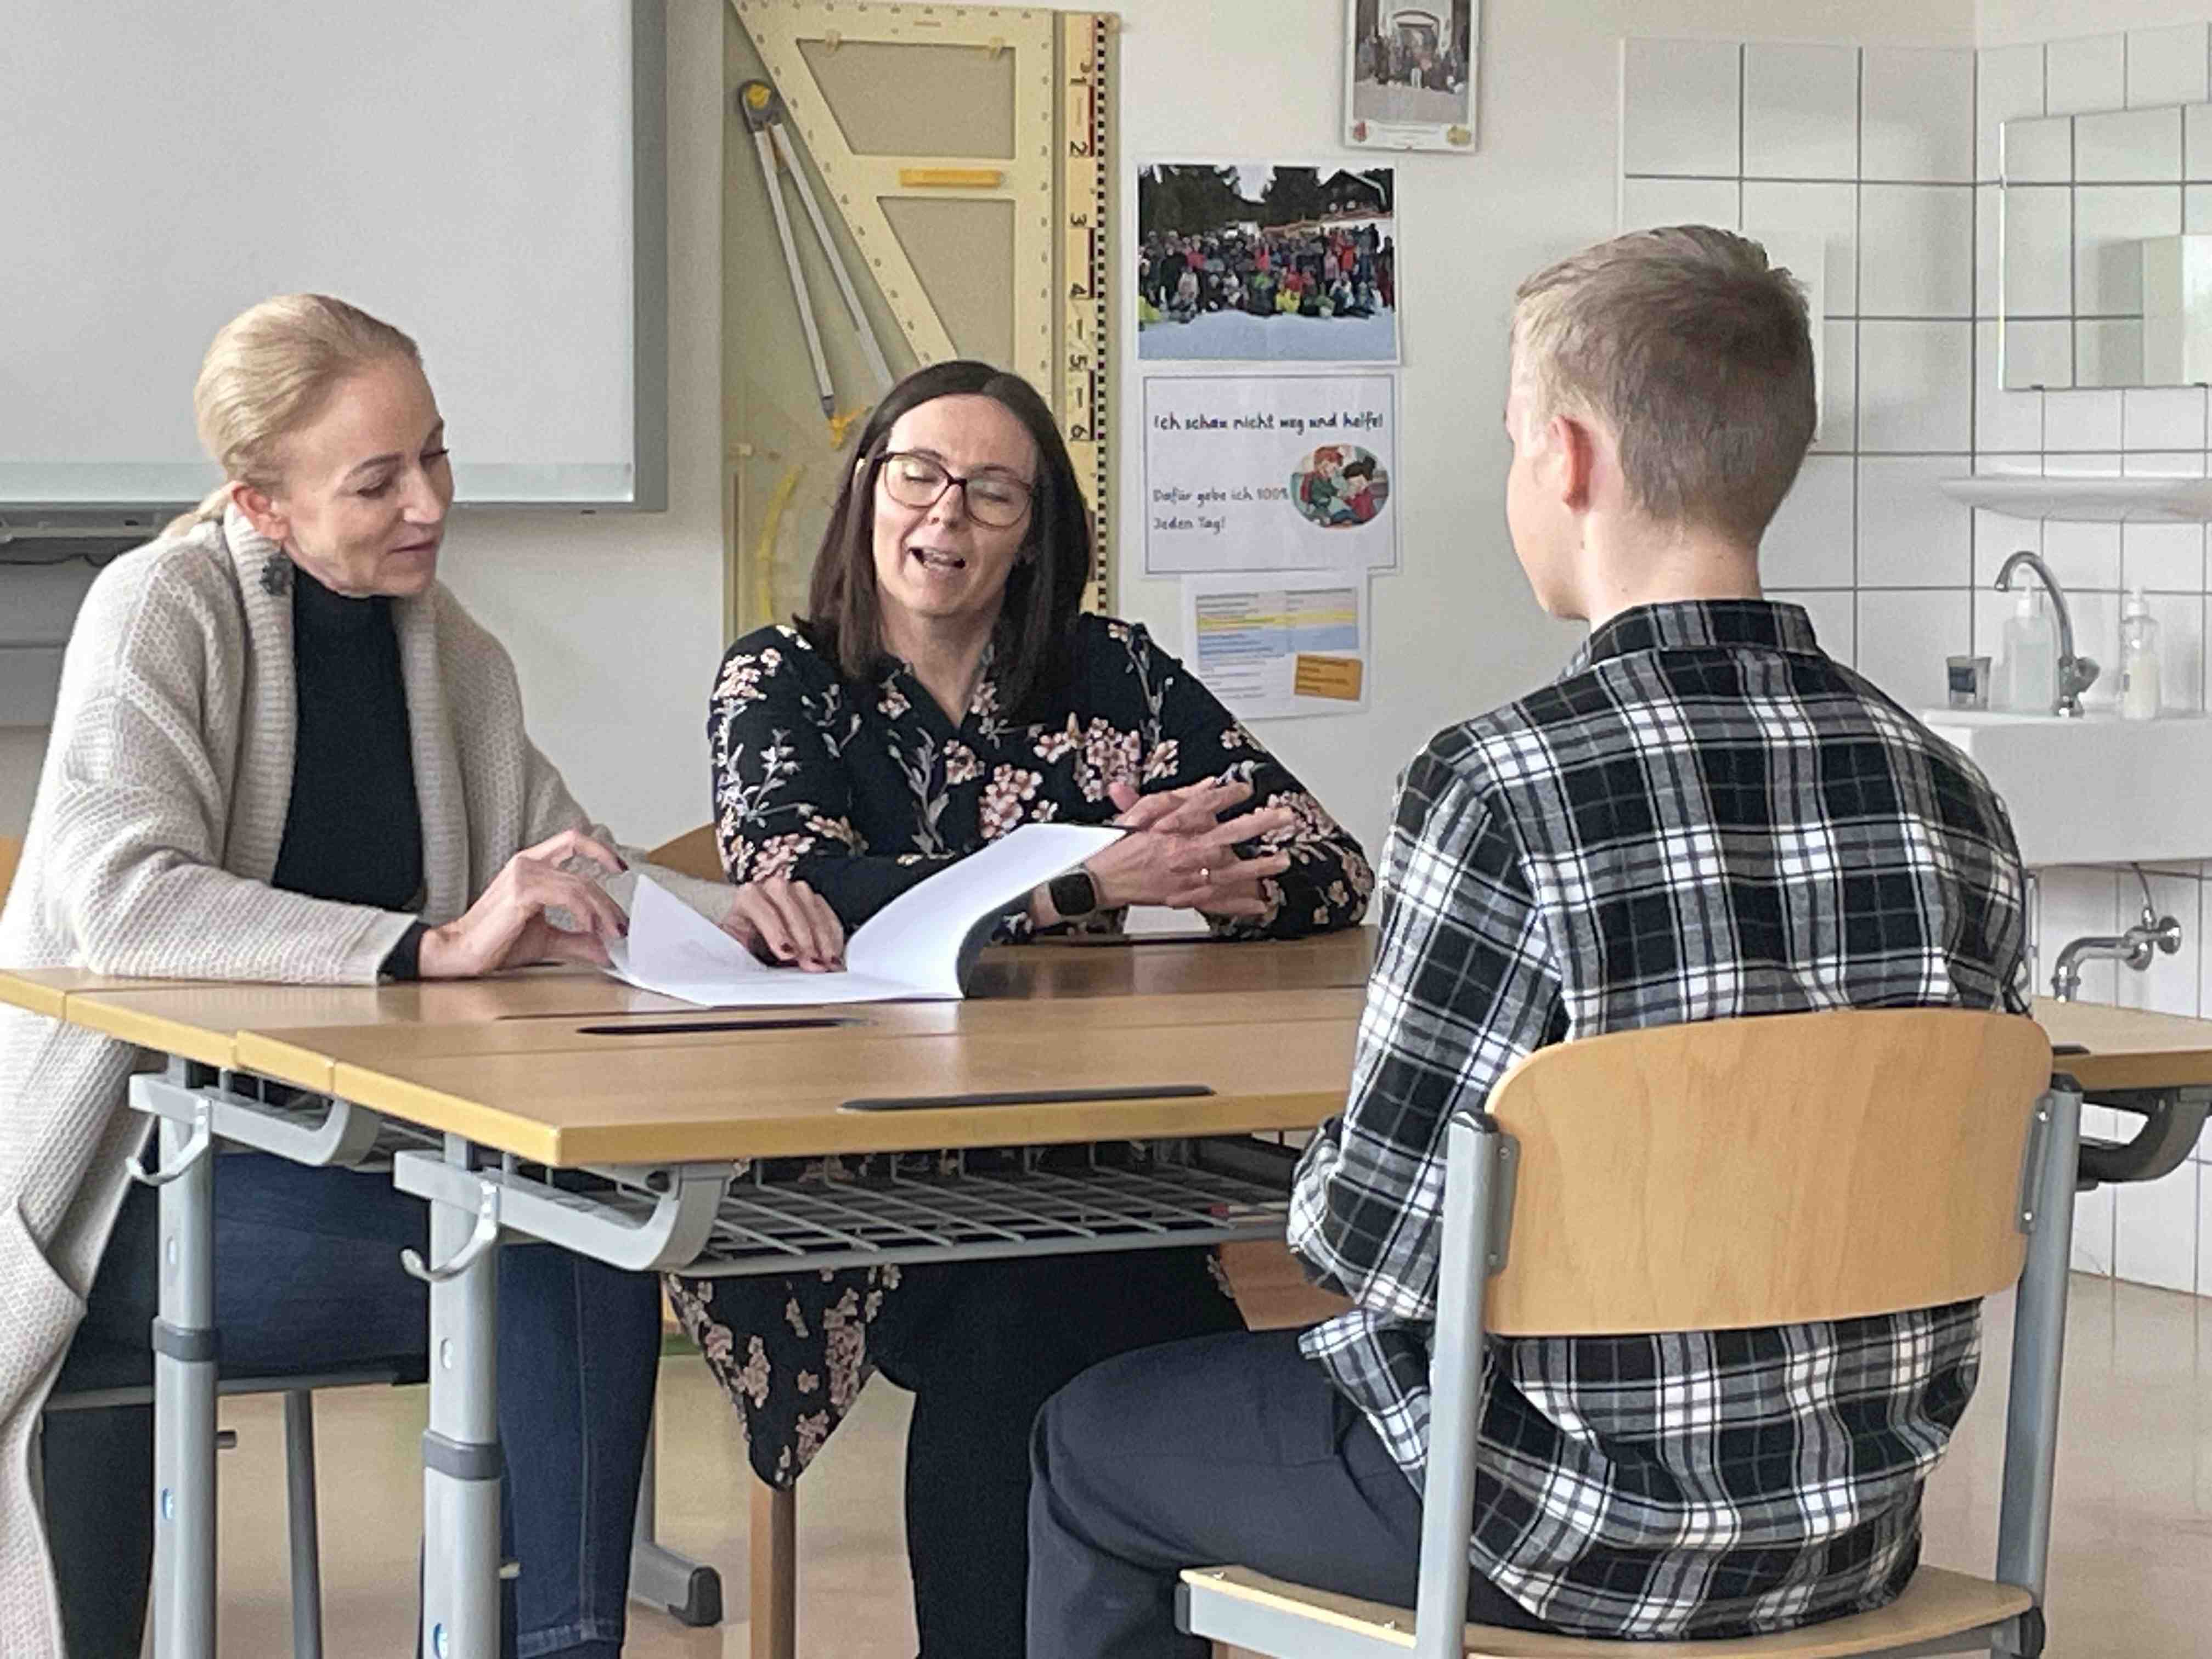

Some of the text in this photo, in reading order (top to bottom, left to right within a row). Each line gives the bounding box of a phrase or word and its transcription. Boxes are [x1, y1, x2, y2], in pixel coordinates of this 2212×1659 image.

[1070, 141, 1088, 156] 2
[1070, 213, 1087, 225] 3
[1071, 283, 1087, 297] 4
[1070, 355, 1088, 371] 5
[1070, 424, 1088, 438] 6
[1154, 411, 1181, 430] Ich
[1186, 413, 1227, 430] schau
[1234, 411, 1273, 430] nicht
[1280, 419, 1304, 436] weg
[1310, 413, 1336, 428] und
[1153, 487, 1191, 505] Dafür
[1198, 487, 1226, 508] gebe
[1231, 487, 1253, 500] ich
[1154, 516, 1226, 535] Jeden Tag!
